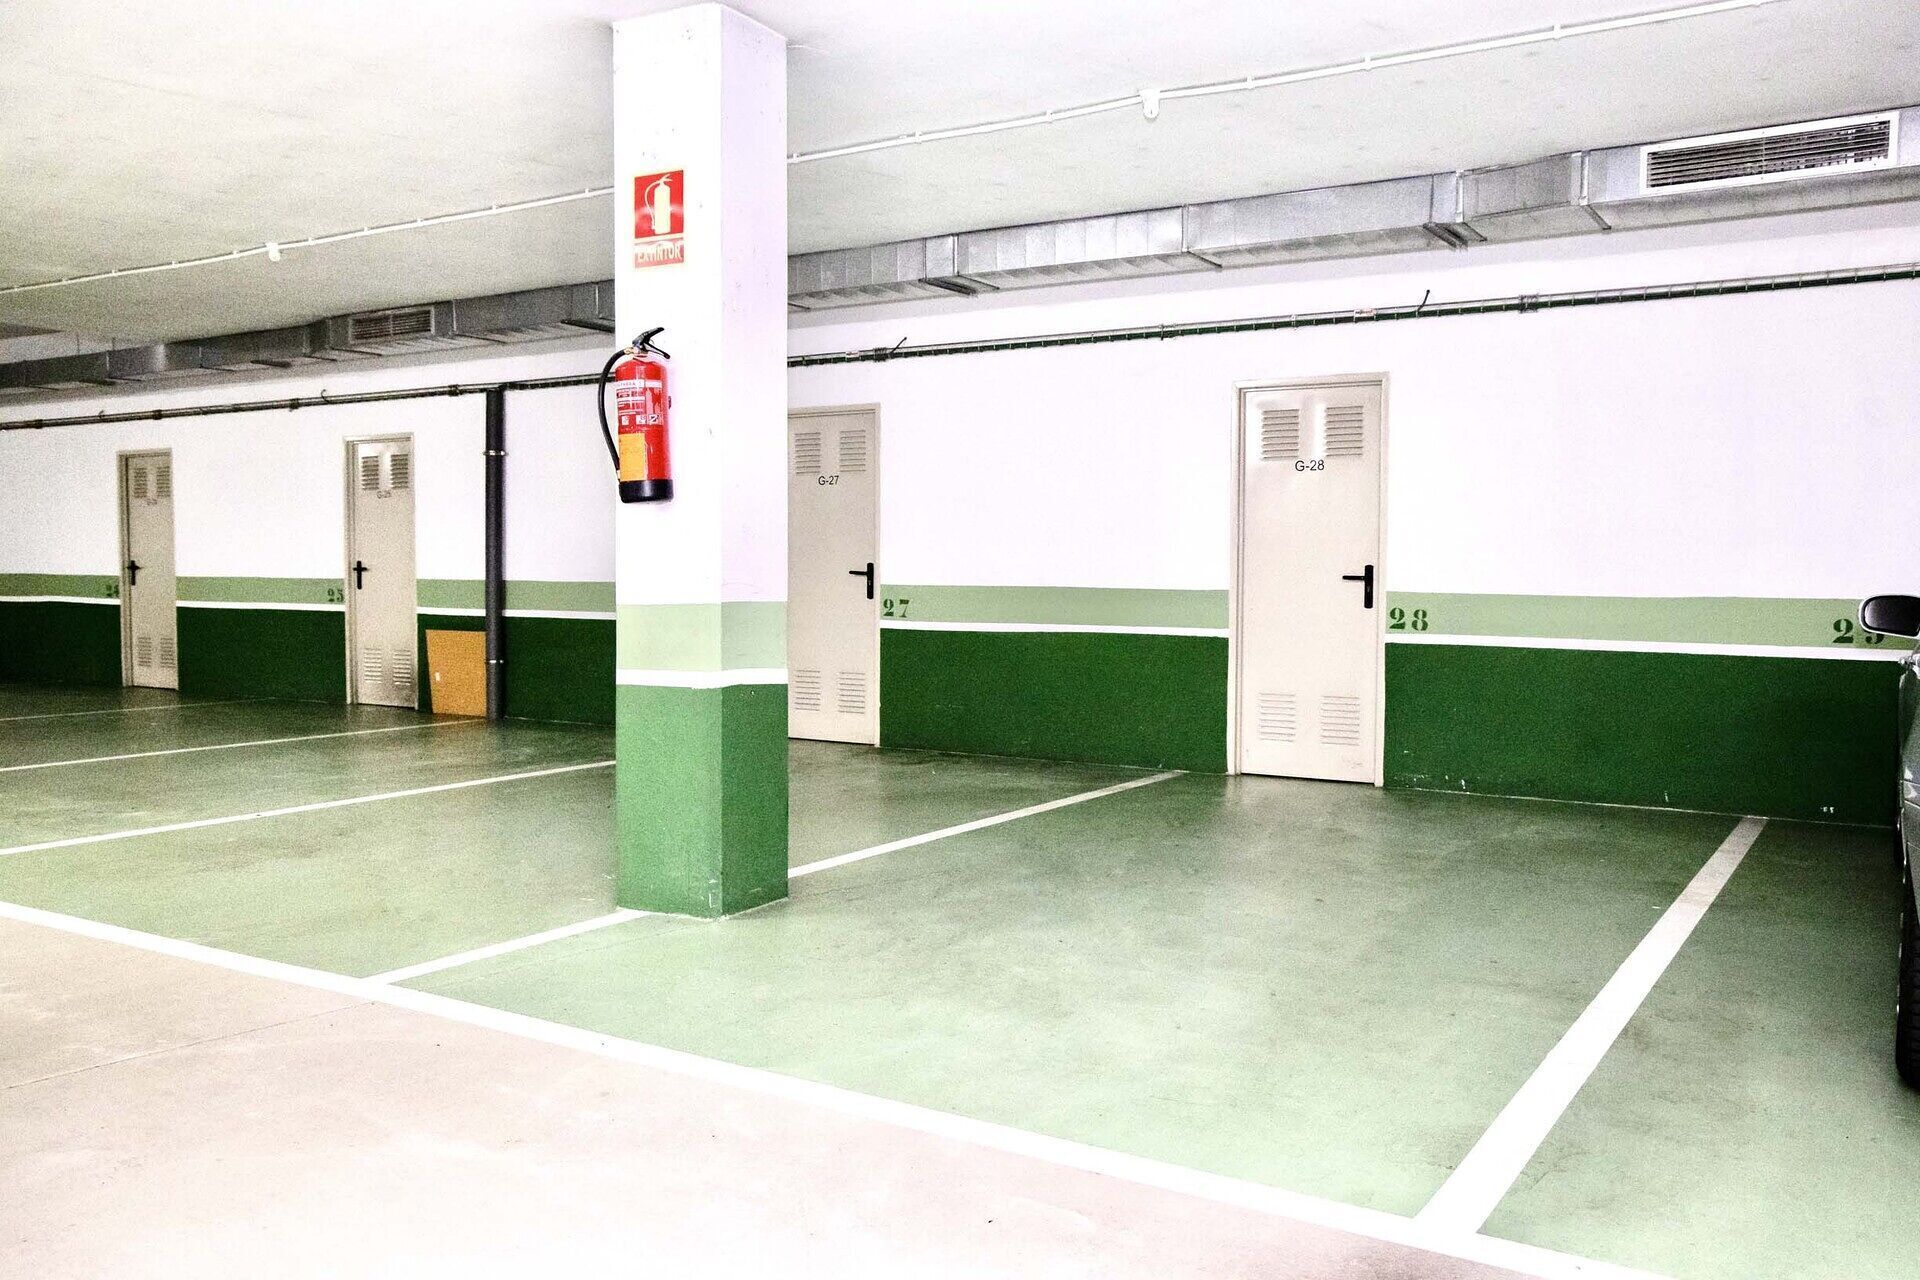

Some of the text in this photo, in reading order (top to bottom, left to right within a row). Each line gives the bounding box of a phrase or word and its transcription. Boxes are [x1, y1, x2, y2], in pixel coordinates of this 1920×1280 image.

[636, 243, 682, 263] EXTINTOR
[1295, 459, 1325, 471] G-28
[818, 475, 839, 486] G-27
[883, 598, 910, 618] 27
[1389, 607, 1428, 631] 28
